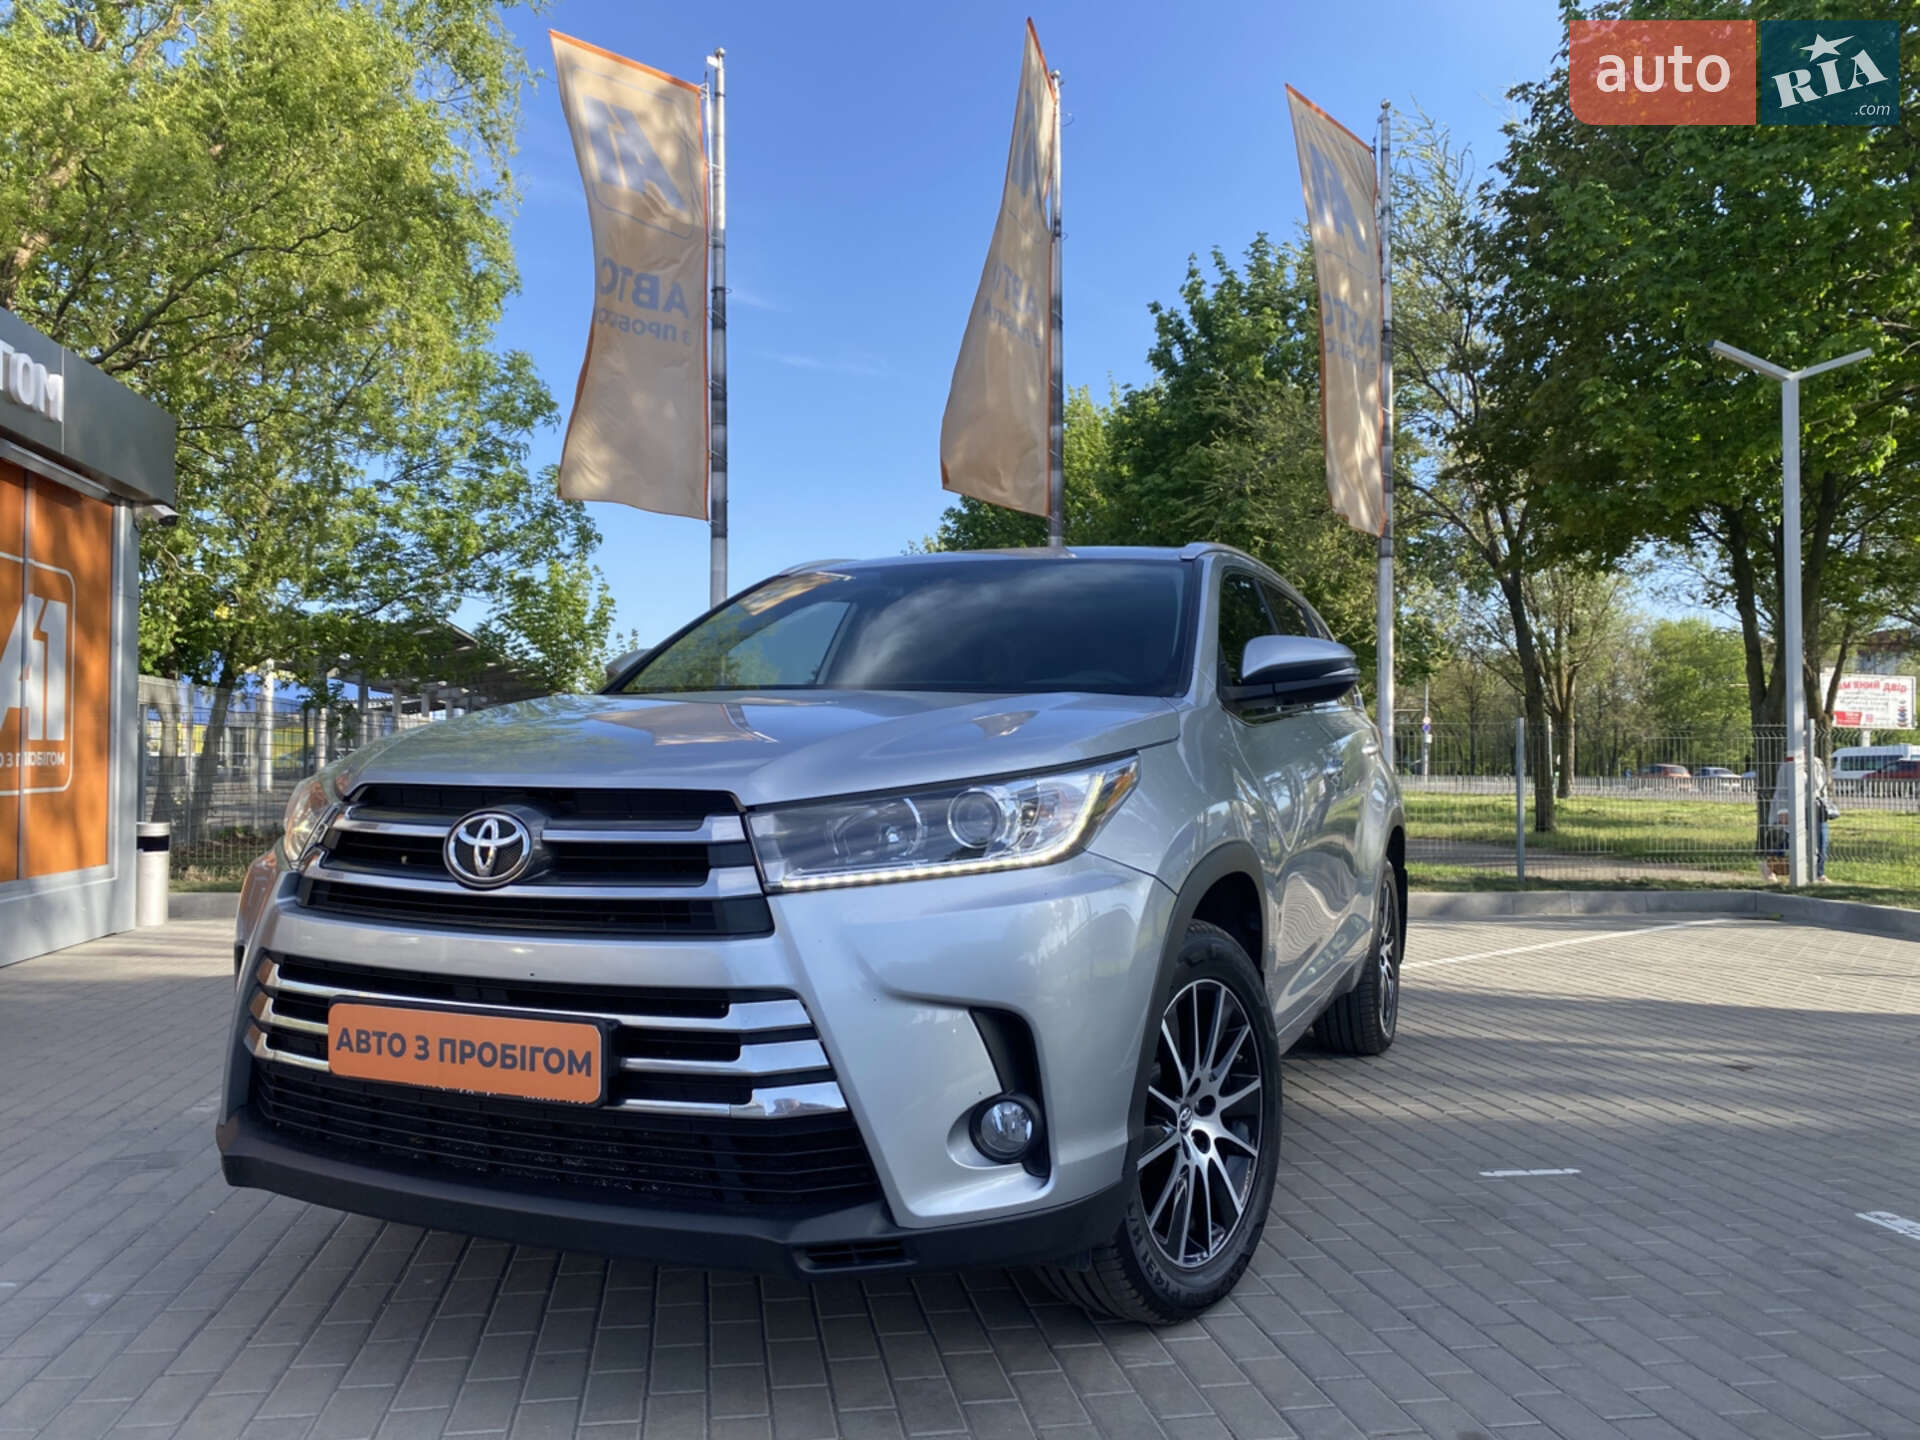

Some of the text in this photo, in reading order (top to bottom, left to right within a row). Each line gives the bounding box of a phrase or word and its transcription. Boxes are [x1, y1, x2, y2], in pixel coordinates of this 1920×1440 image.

[336, 1027, 592, 1078] АВТО З ПРОБІГОМ
